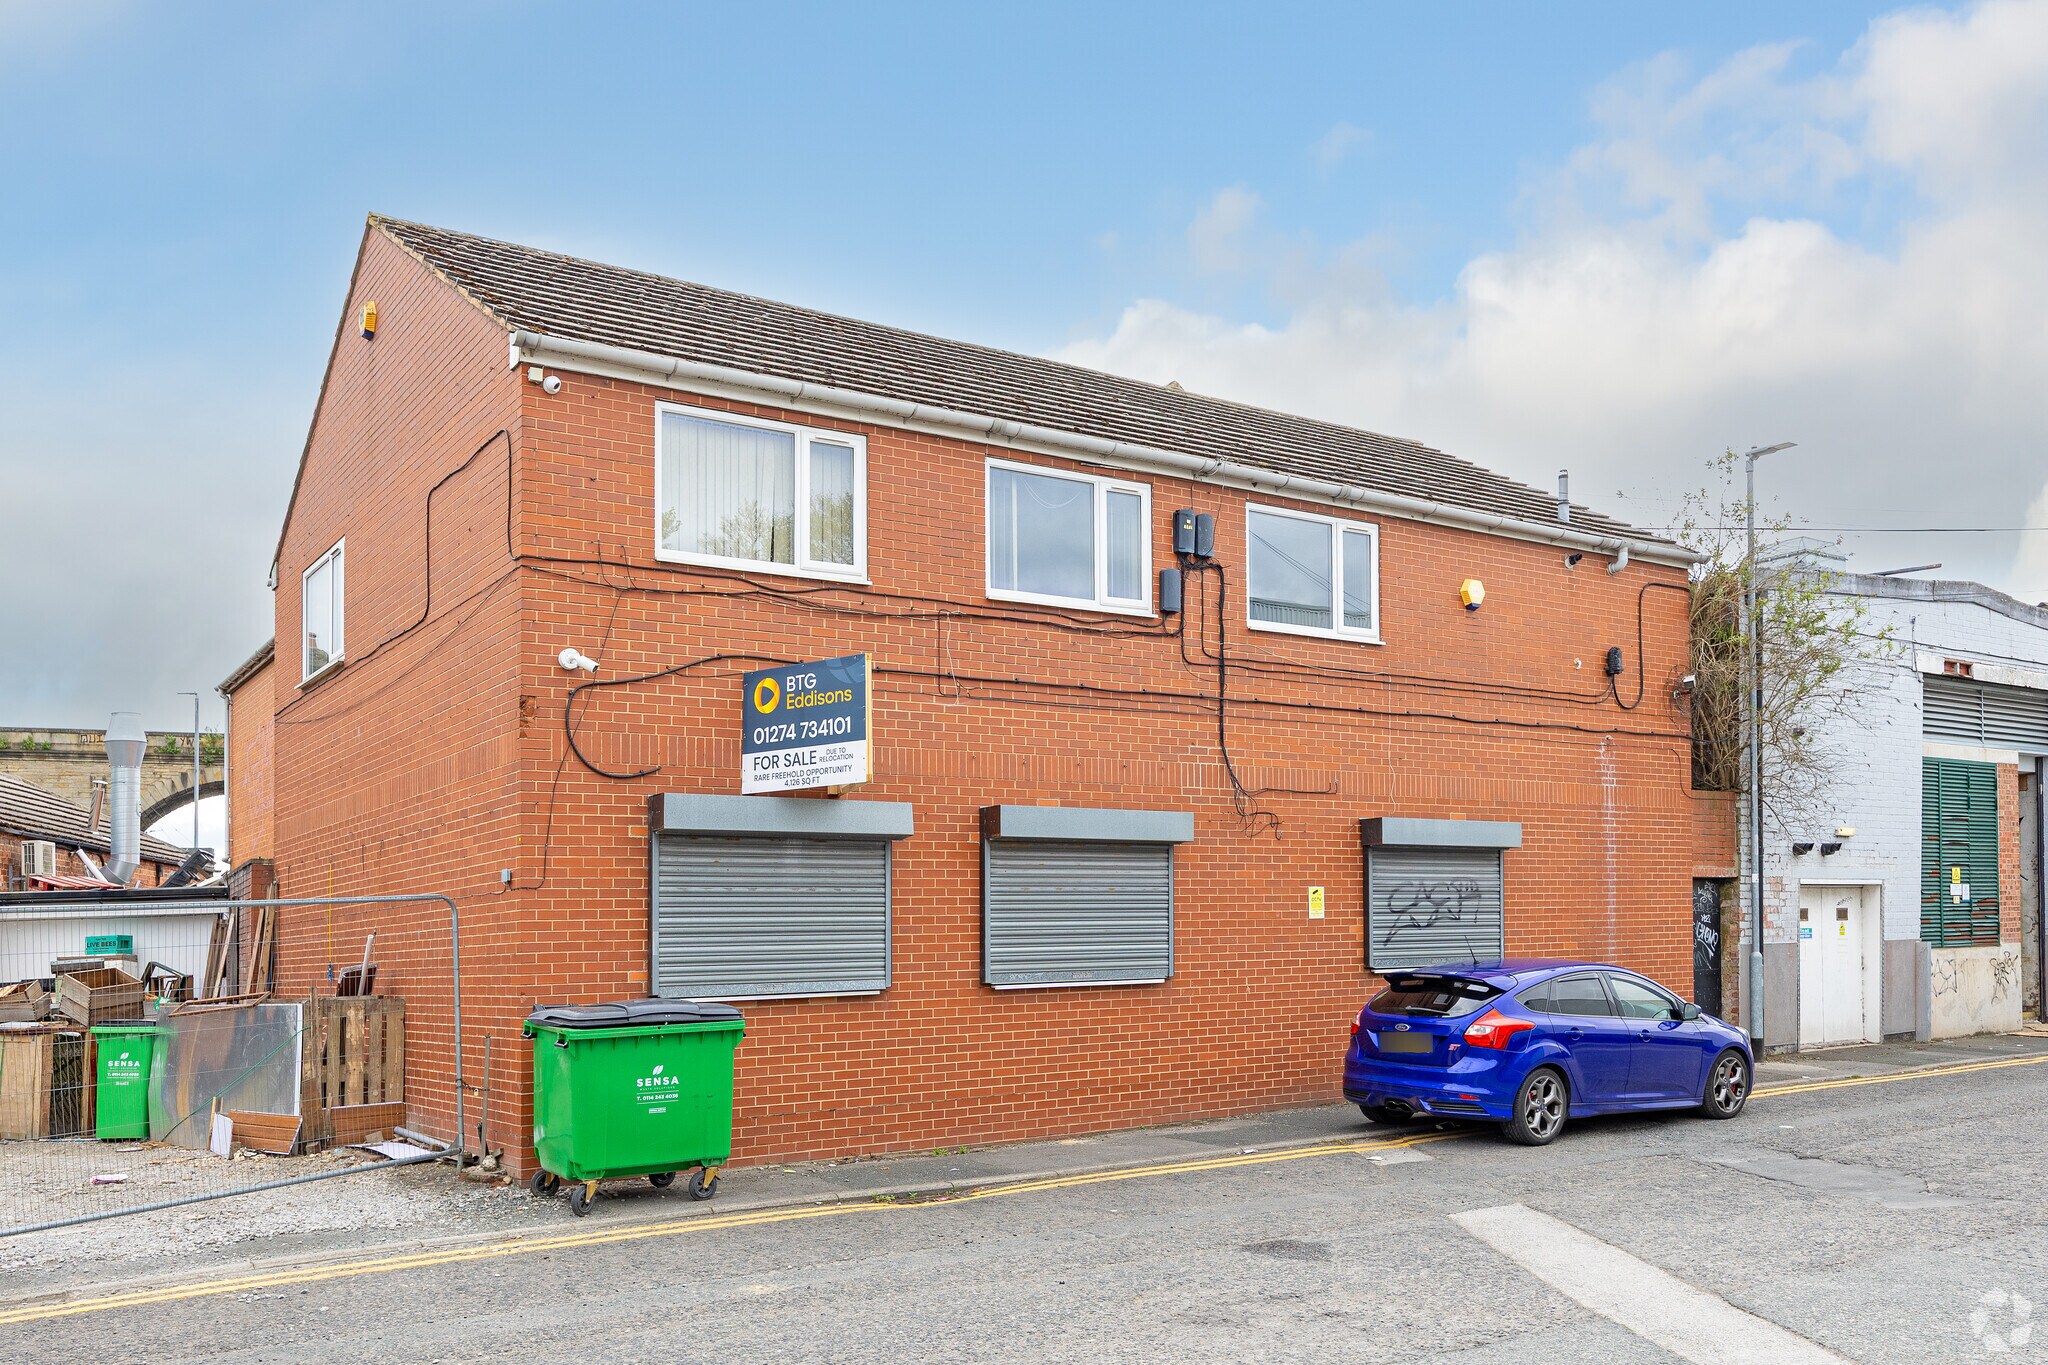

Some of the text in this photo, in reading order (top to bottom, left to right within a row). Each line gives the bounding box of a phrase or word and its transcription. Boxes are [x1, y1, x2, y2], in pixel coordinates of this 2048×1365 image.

[786, 673, 817, 692] BTG
[786, 689, 852, 710] Eddisons
[753, 716, 851, 745] 01274 734101
[753, 750, 817, 771] FOR SALE
[819, 753, 854, 762] RELOCATION
[753, 765, 853, 781] RARE FREEHOLD OPPORTUNITY
[784, 776, 820, 787] 4,126 SQ FT
[637, 1076, 679, 1087] SENSA
